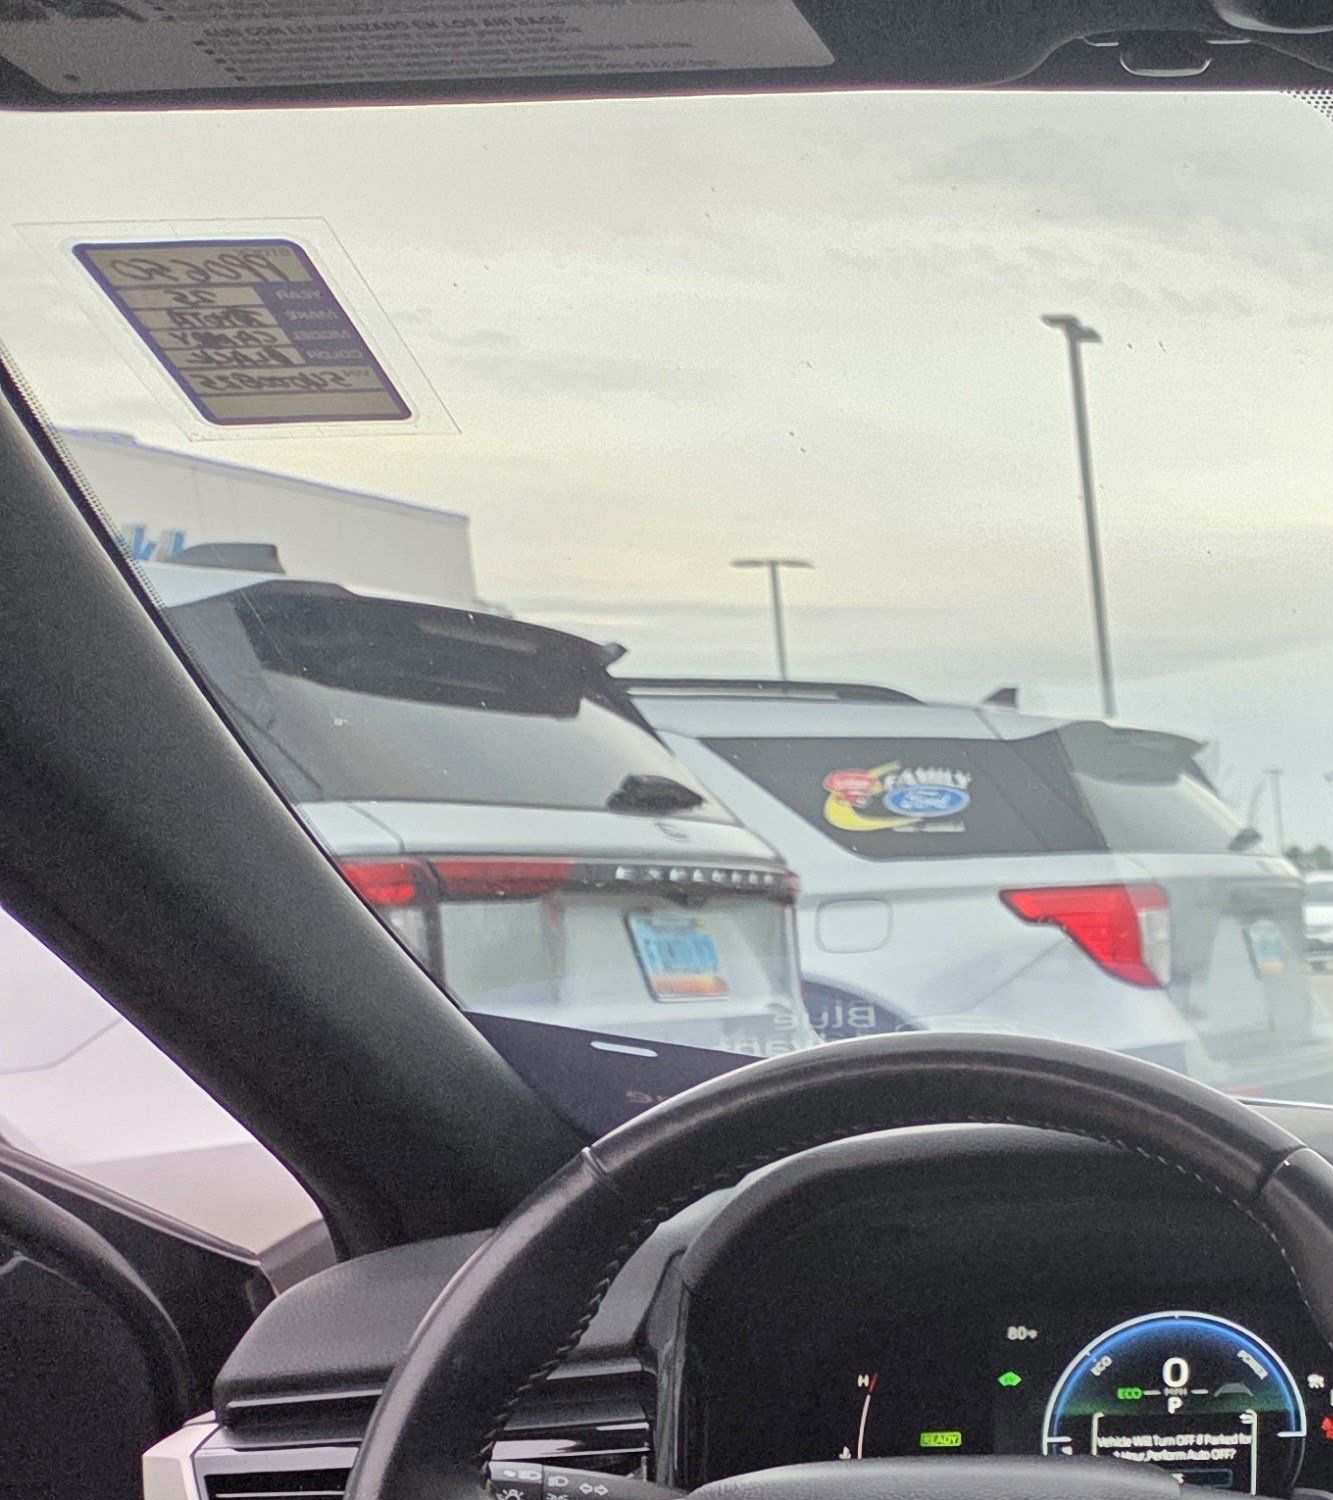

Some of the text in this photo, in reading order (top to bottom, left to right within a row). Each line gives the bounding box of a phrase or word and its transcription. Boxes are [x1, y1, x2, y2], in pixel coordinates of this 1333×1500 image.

[1162, 1357, 1190, 1388] 0
[857, 1374, 870, 1388] H
[1117, 1387, 1144, 1400] ECO
[1167, 1396, 1183, 1414] P
[922, 1434, 960, 1445] READY
[1097, 1435, 1132, 1448] Vehicle
[1132, 1434, 1152, 1447] Will
[1152, 1434, 1175, 1447] Turn
[1175, 1434, 1196, 1446] OFF
